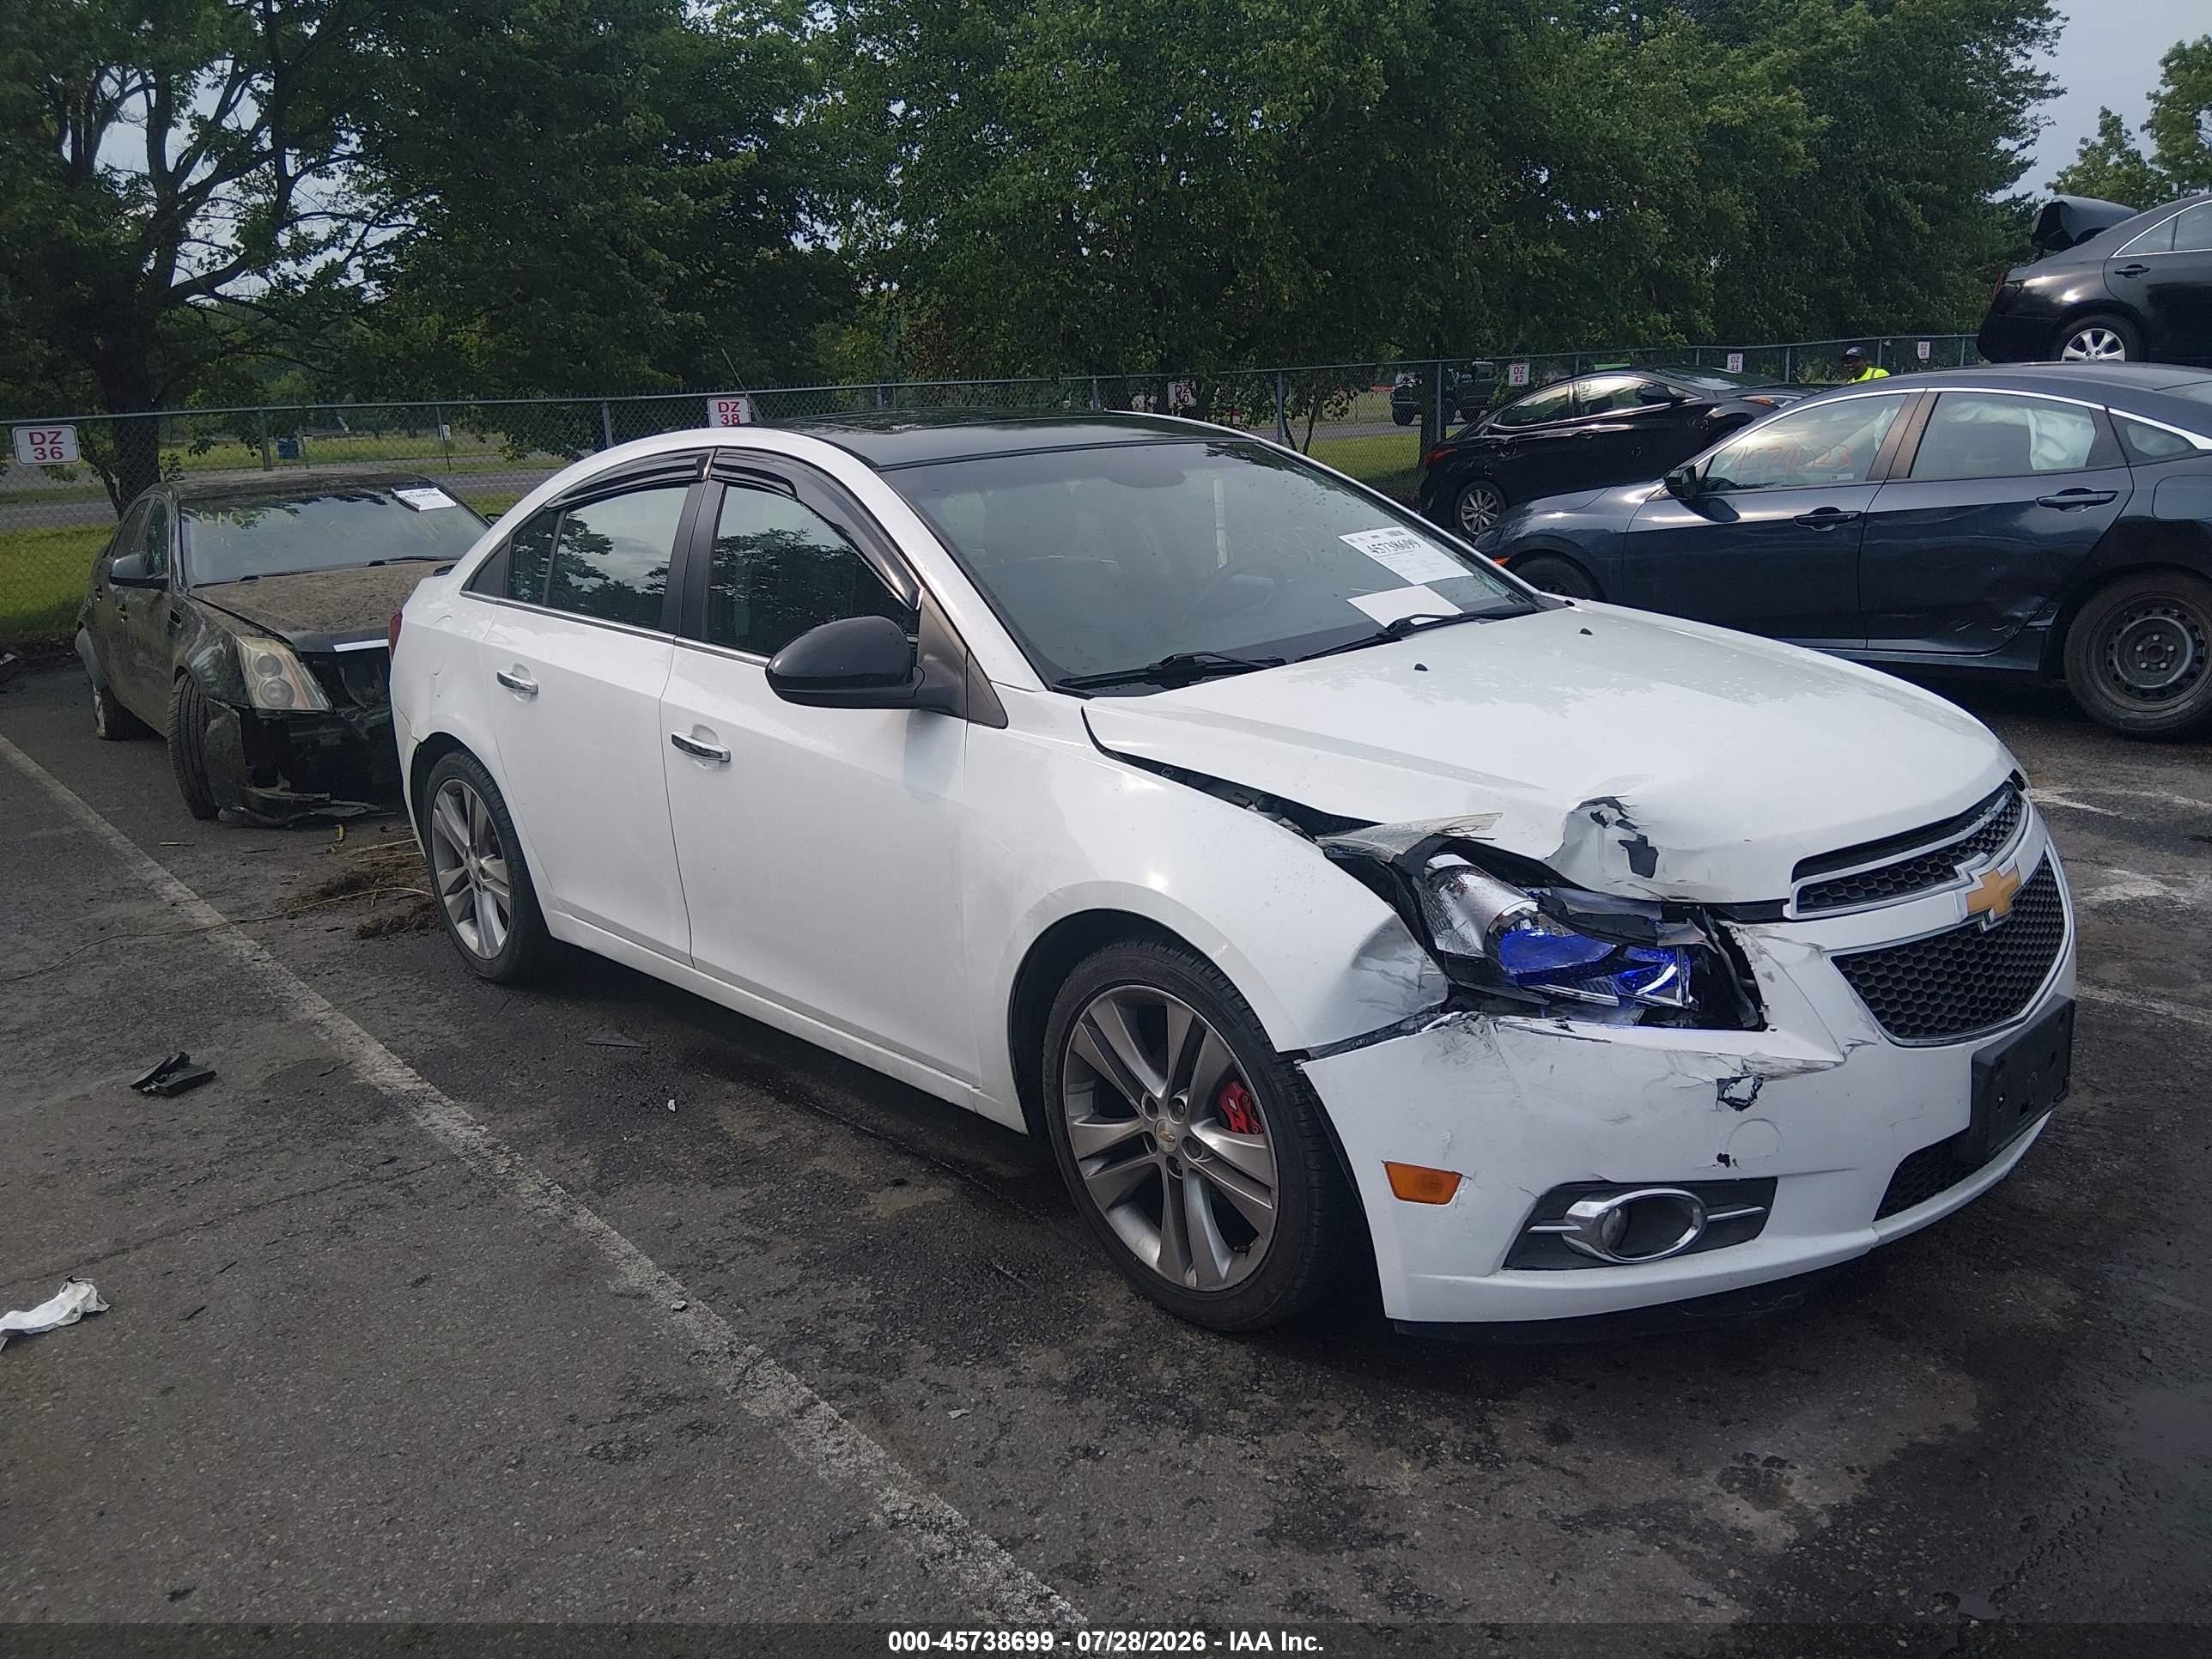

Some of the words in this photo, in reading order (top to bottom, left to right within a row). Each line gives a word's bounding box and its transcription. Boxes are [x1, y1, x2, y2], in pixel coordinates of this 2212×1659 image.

[1513, 366, 1525, 375] DZ
[1175, 384, 1190, 394] DZ
[718, 401, 741, 413] DZ
[720, 413, 740, 426] 38
[29, 430, 64, 446] DZ
[33, 447, 64, 461] 36
[1366, 538, 1422, 555] 45738699
